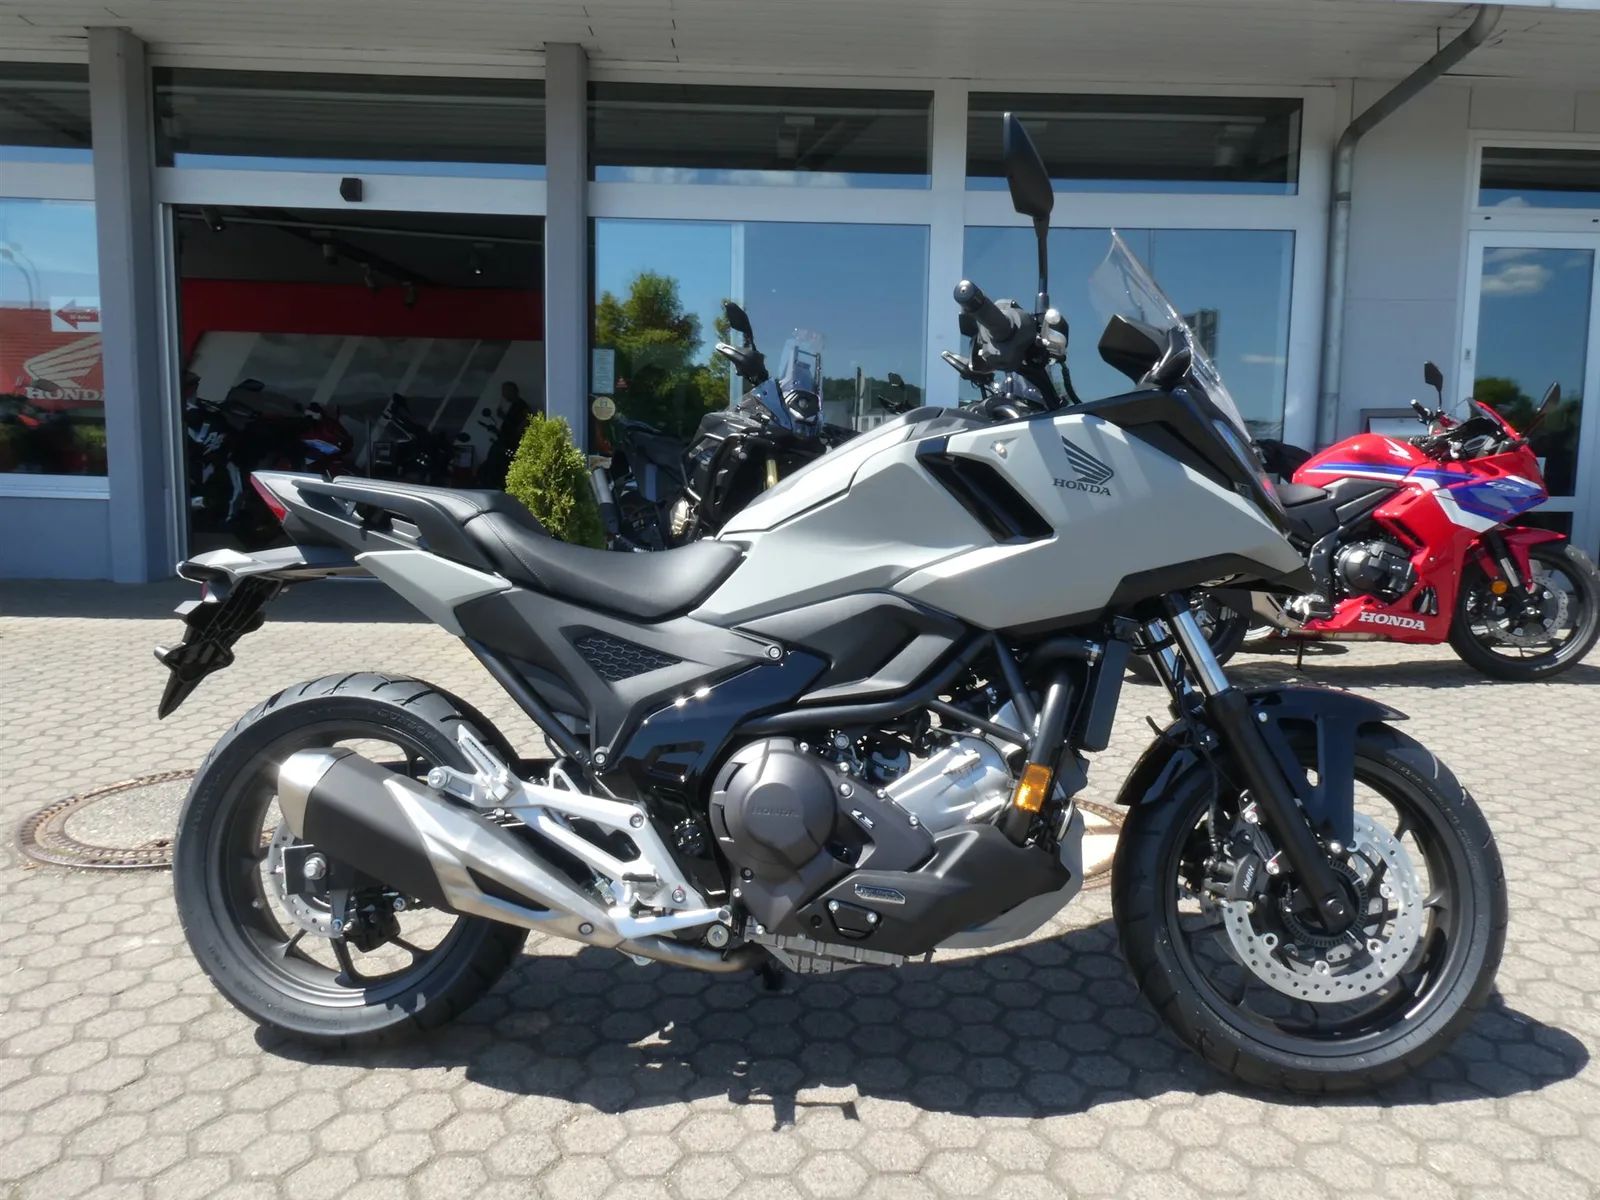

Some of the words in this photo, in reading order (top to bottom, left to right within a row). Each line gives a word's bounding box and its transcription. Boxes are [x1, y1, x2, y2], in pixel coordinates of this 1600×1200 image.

[1052, 478, 1112, 496] HONDA
[1359, 611, 1426, 631] HONDA
[751, 806, 800, 818] HONDA
